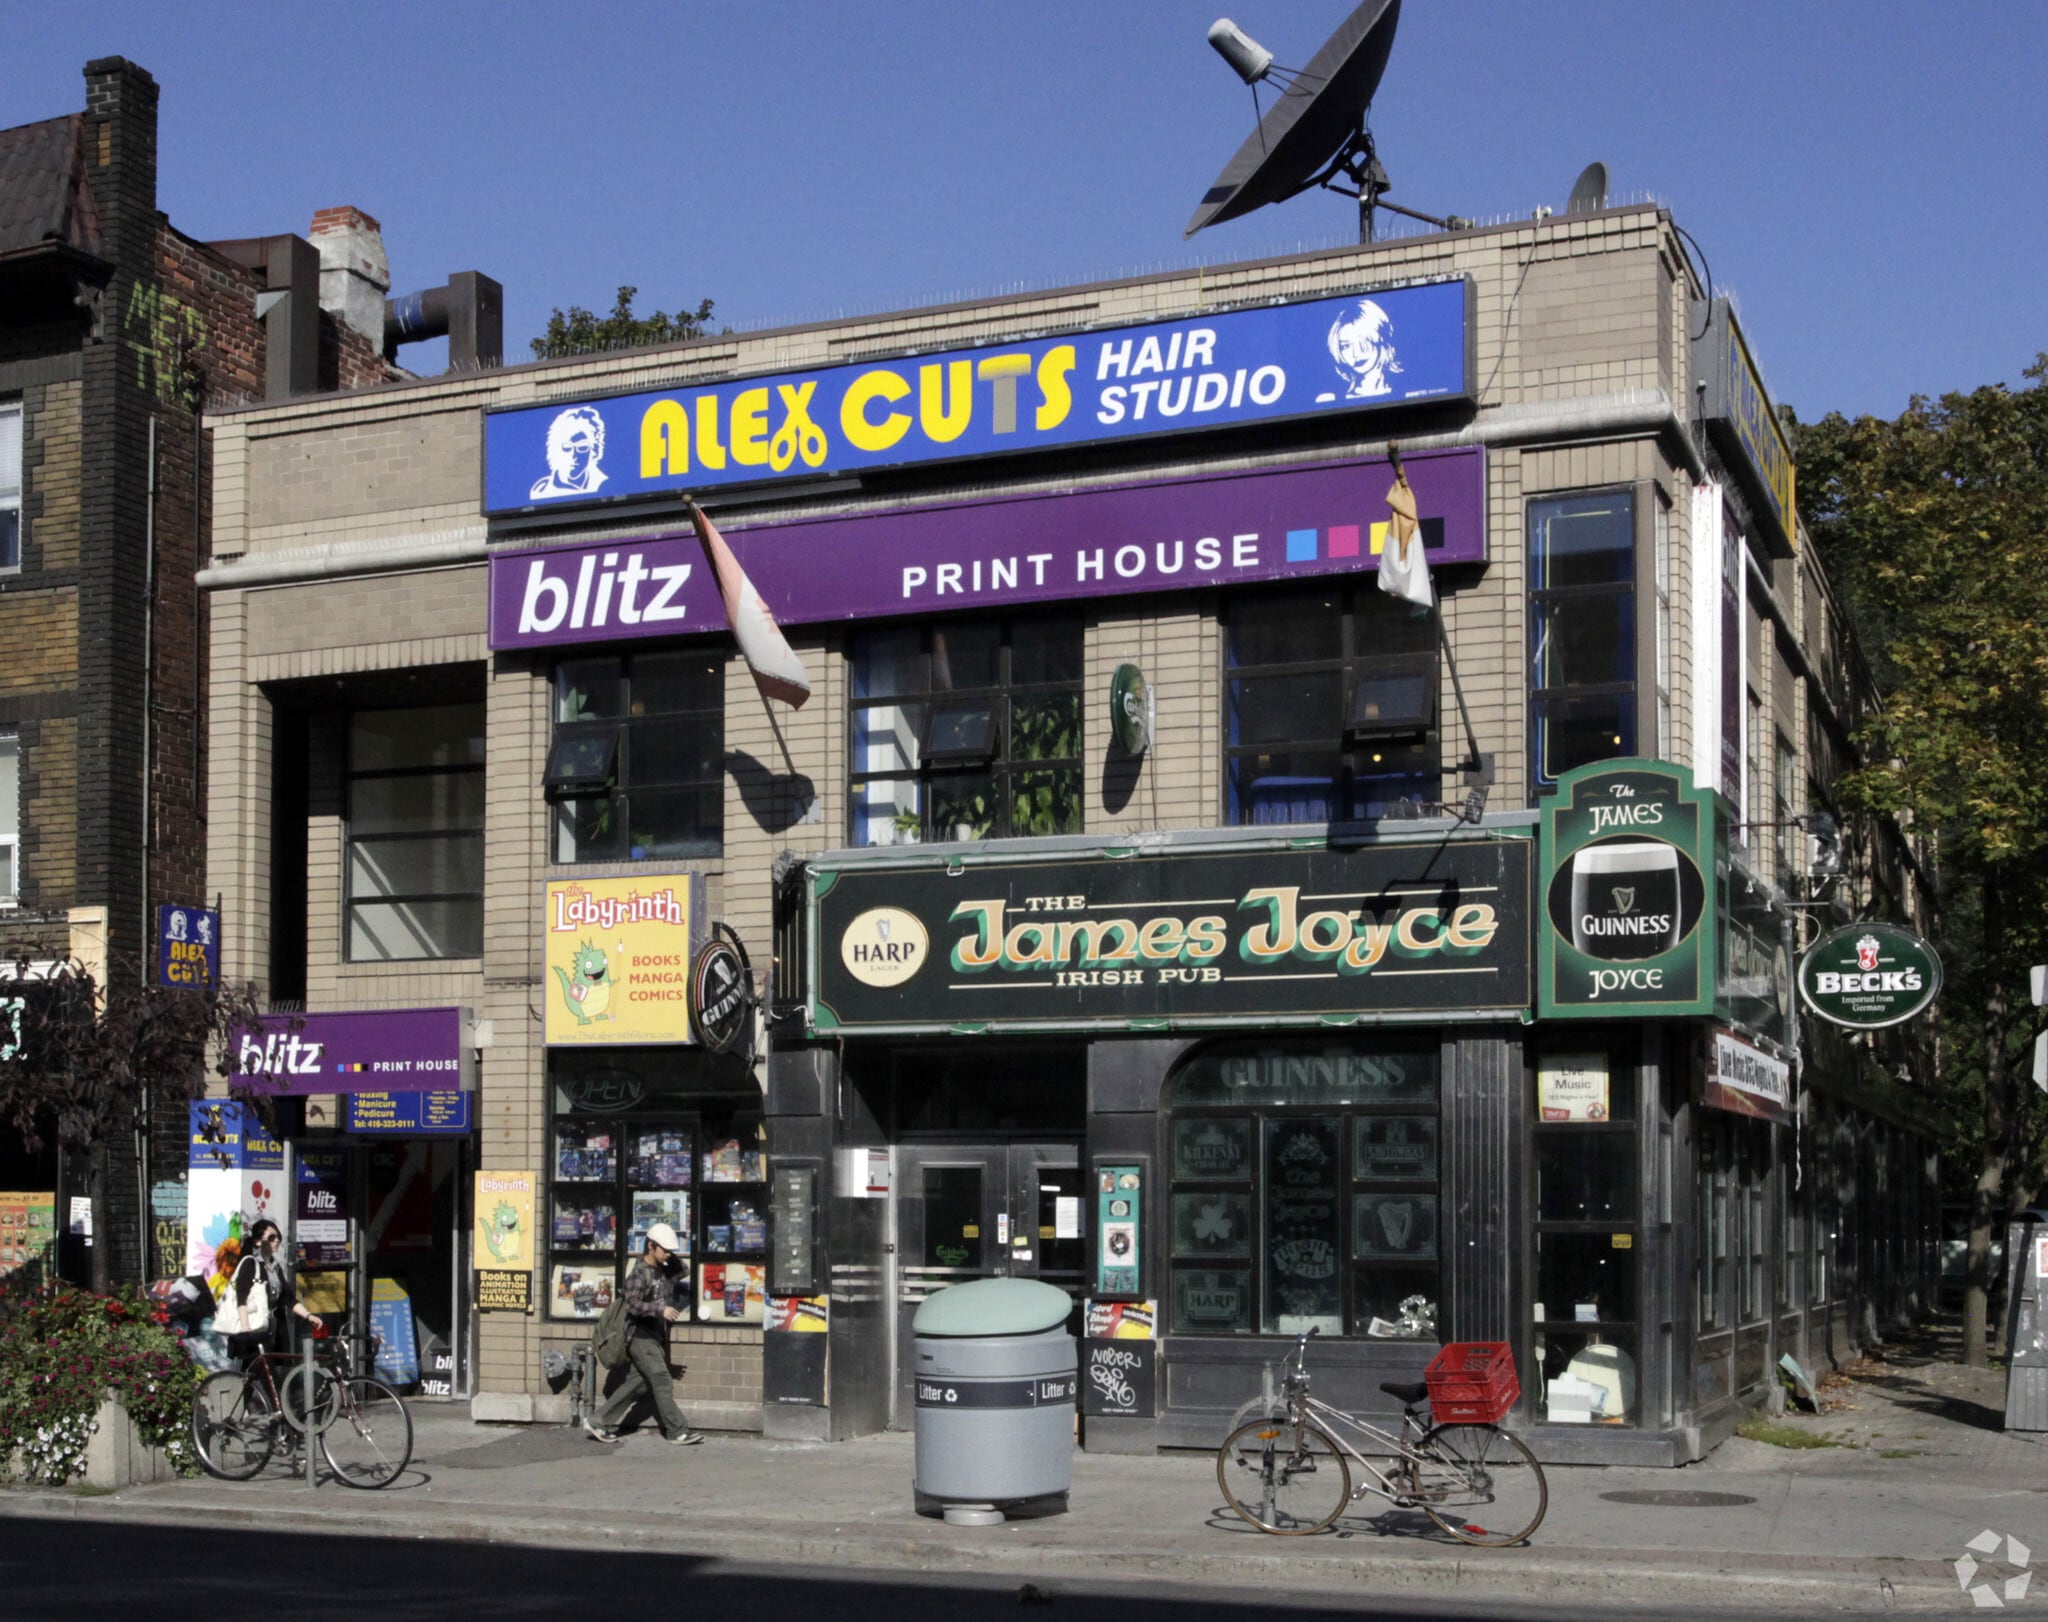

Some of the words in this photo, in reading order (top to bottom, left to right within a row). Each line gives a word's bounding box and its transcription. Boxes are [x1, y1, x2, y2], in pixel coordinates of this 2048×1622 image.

[1096, 328, 1217, 380] HAIR
[1096, 365, 1286, 424] STUDIO
[640, 381, 828, 479] ALEX
[839, 345, 1076, 452] CUTS
[518, 552, 692, 634] blitz
[903, 553, 1053, 598] PRINT
[1077, 534, 1259, 581] HOUSE
[1609, 784, 1635, 798] The
[1589, 802, 1663, 835] JAMES
[552, 888, 684, 933] Labyrinth
[1025, 896, 1086, 912] THE
[948, 899, 1227, 972] James
[1238, 886, 1499, 975] Joyce
[1581, 914, 1670, 936] GUINNESS
[170, 940, 207, 965] ALEX
[632, 955, 681, 967] BOOKS
[854, 942, 915, 963] HARP
[629, 972, 684, 984] MANGA
[1055, 970, 1145, 988] IRISH
[1159, 967, 1222, 985] PUB
[1589, 968, 1663, 999] JOYCE
[629, 990, 683, 1002] COMICS
[1841, 996, 1875, 1004] Imported
[1852, 1003, 1886, 1012] Germany
[240, 1034, 321, 1075] blitz
[374, 1061, 411, 1072] PRINT
[416, 1060, 458, 1071] HOUSE
[1221, 1056, 1405, 1087] GUINNESS
[1555, 1079, 1591, 1089] Music
[358, 1100, 397, 1108] Manicure
[358, 1109, 395, 1117] Pedicure
[480, 1176, 529, 1193] Labyrinth
[307, 1190, 337, 1208] blitz
[480, 1271, 511, 1281] Books
[514, 1273, 527, 1281] on
[480, 1281, 527, 1289] ANIMATION
[480, 1295, 516, 1303] MANGA
[519, 1295, 527, 1303] &
[919, 1383, 943, 1401] Litter
[1042, 1383, 1065, 1399] Litter
